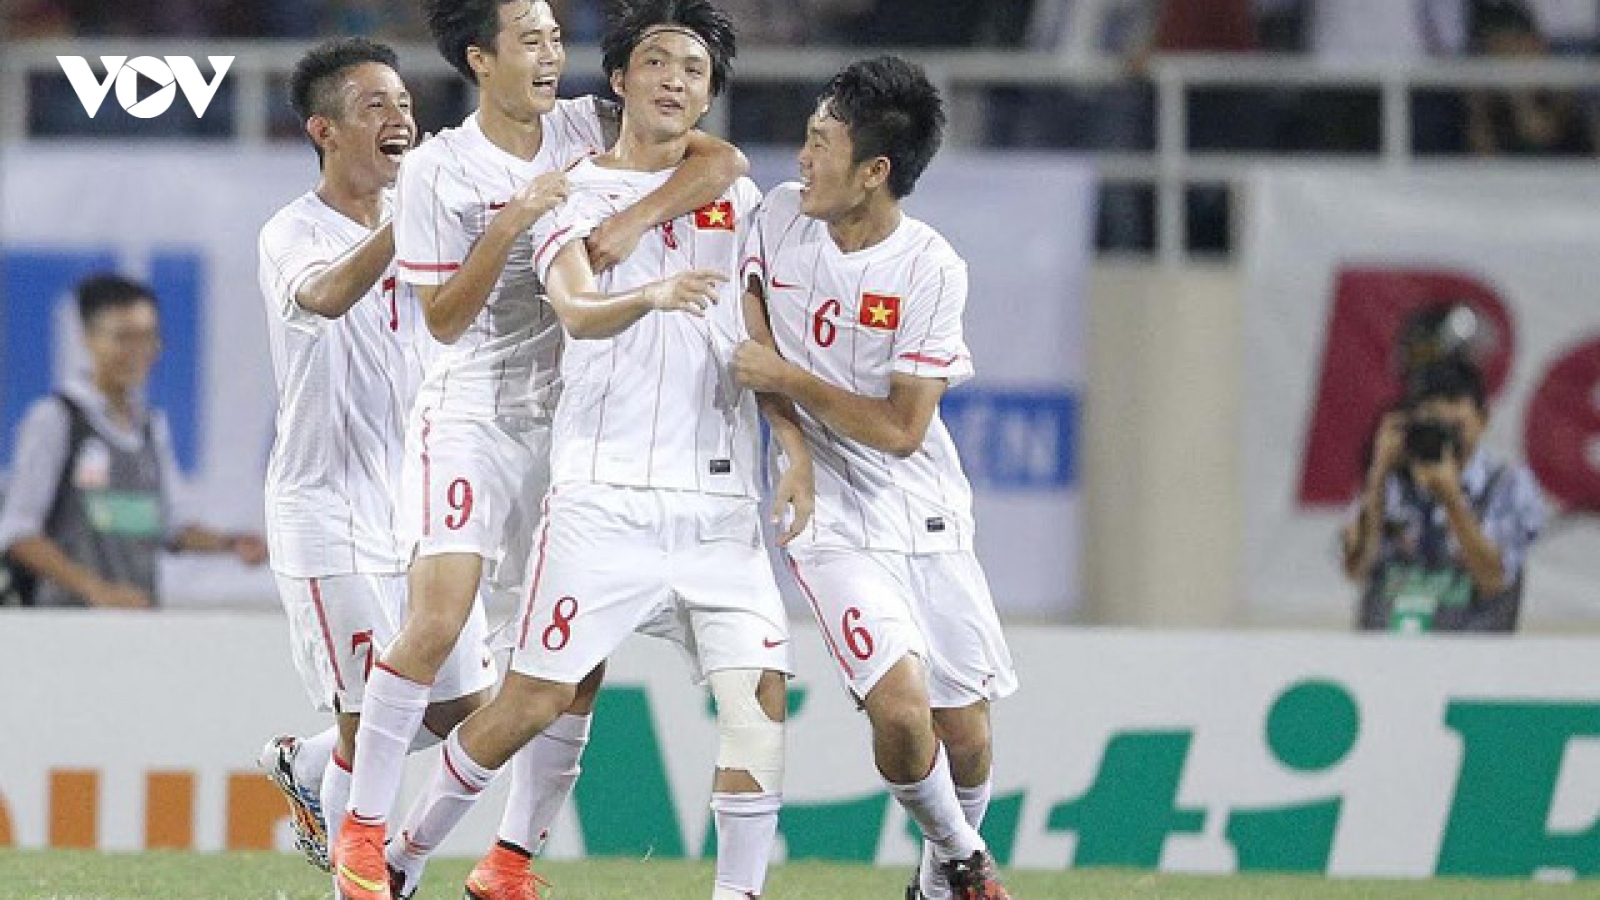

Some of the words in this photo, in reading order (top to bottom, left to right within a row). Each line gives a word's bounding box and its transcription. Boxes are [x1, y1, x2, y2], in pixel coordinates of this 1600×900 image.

[813, 299, 841, 348] 6
[446, 478, 473, 530] 9
[542, 597, 579, 651] 8
[841, 606, 874, 661] 6
[351, 630, 374, 683] 7
